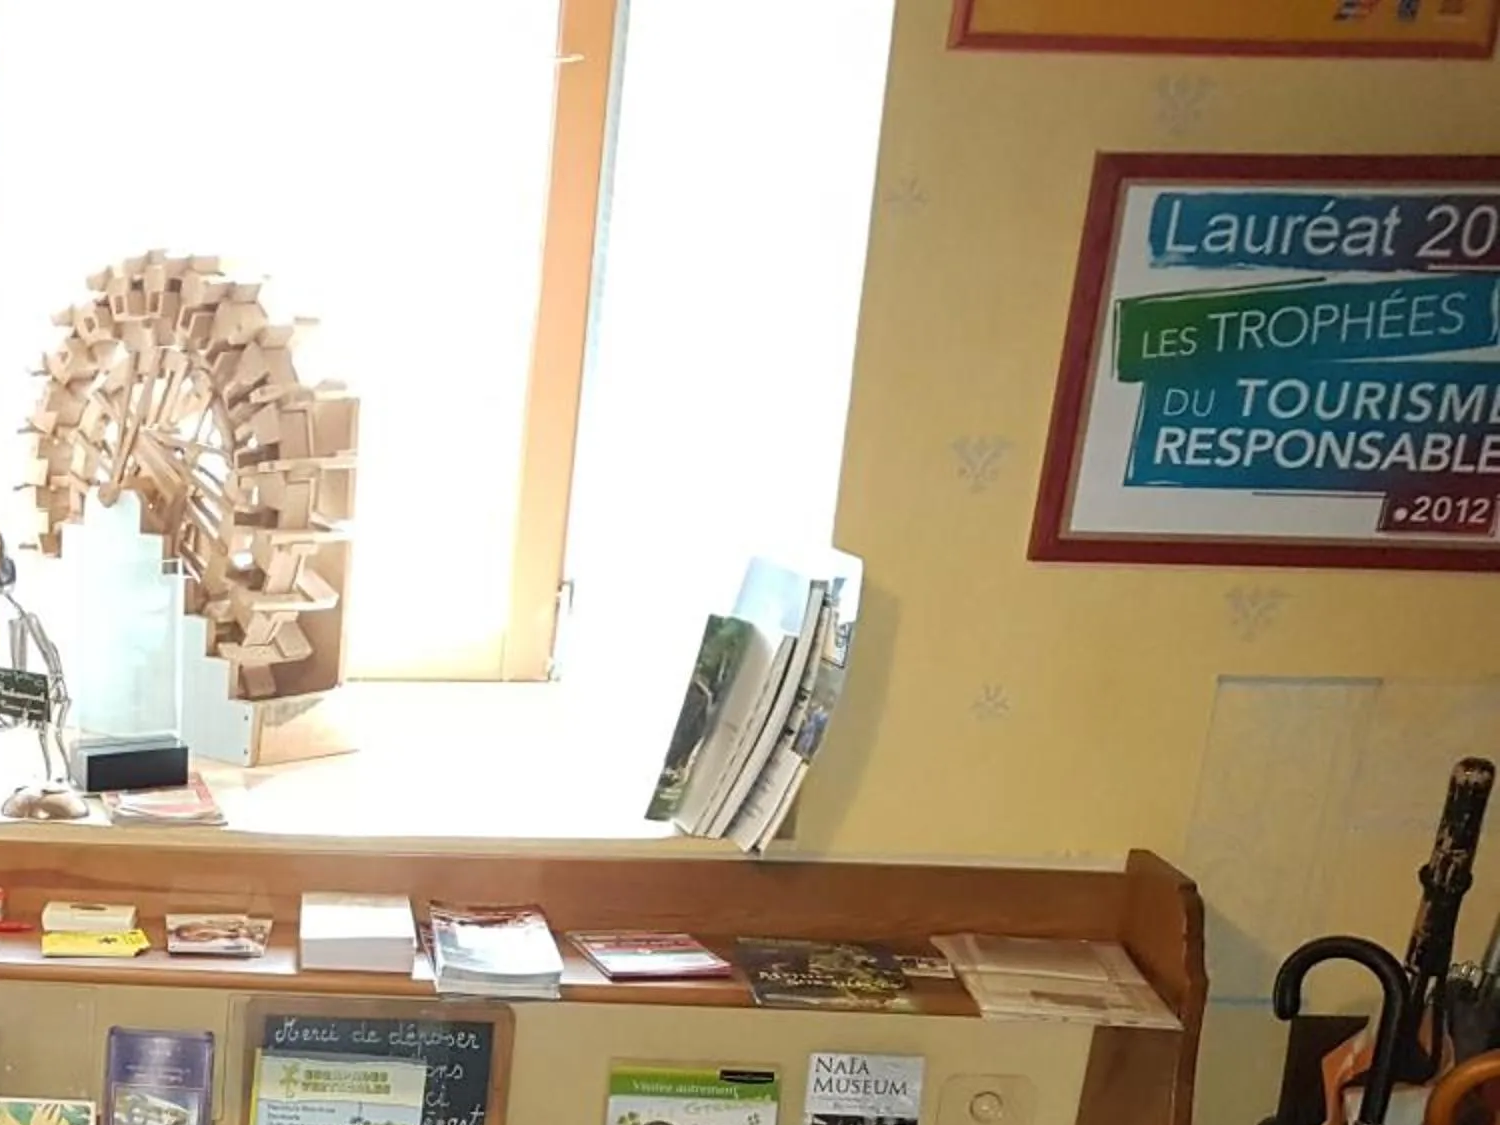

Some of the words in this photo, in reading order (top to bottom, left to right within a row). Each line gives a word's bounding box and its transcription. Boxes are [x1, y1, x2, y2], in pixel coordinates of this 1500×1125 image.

[1165, 200, 1401, 258] Lauréat
[1141, 327, 1197, 359] LES
[1208, 290, 1469, 352] TROPHÉES
[1163, 388, 1216, 417] DU
[1153, 427, 1500, 474] RESPONSABLE
[1409, 497, 1489, 524] 2012
[274, 1016, 341, 1043] Merci
[352, 1022, 381, 1044] de
[813, 1077, 908, 1096] MUSEUM
